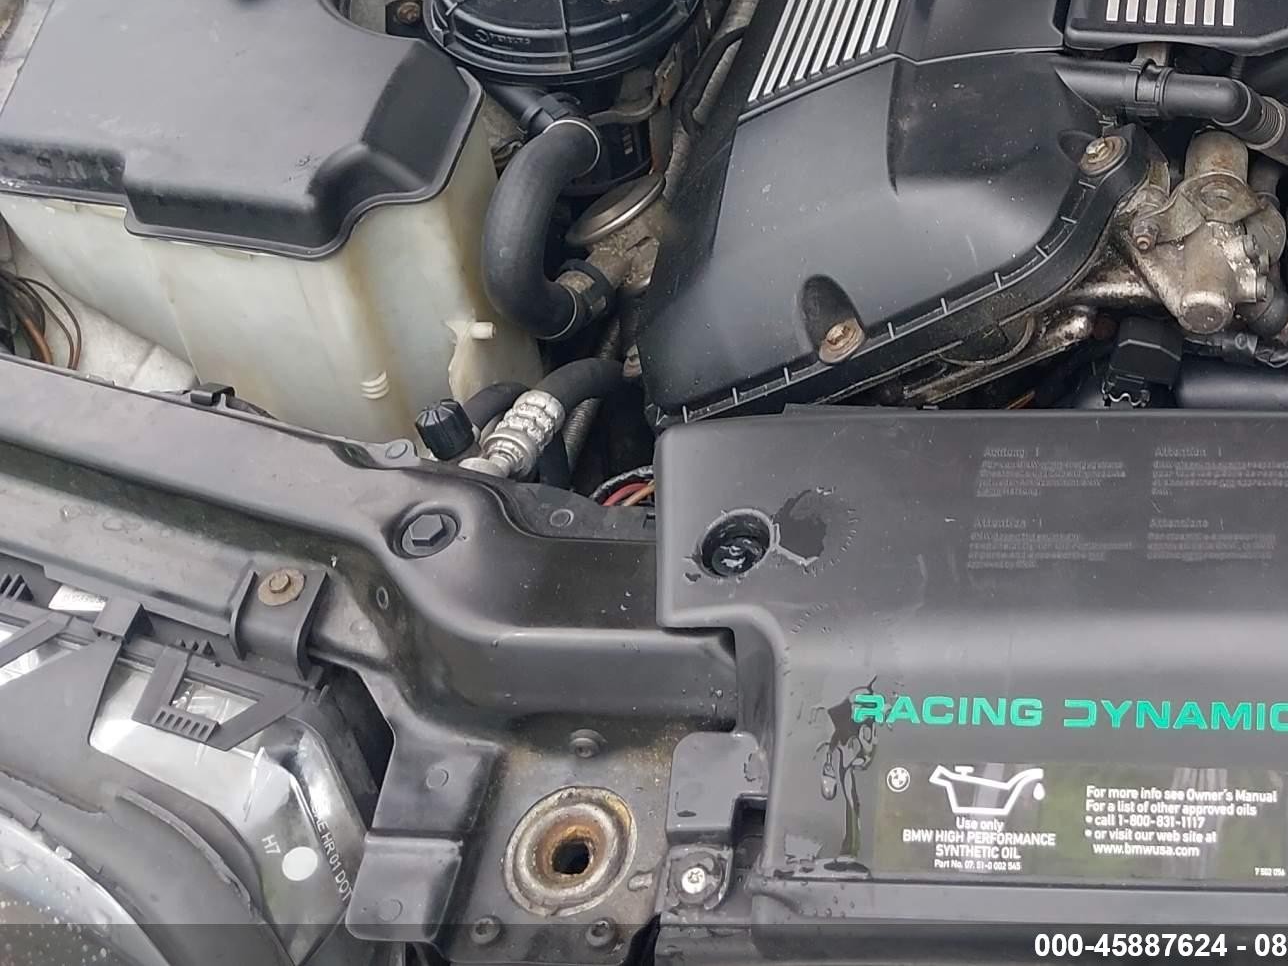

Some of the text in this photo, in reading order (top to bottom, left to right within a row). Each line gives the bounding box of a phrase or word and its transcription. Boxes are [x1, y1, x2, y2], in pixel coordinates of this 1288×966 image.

[851, 694, 1043, 728] RACING
[1086, 785, 1278, 803] For more info see Owner's Manual
[1086, 799, 1258, 818] For a list of other approved oils
[955, 817, 1004, 833] Use only
[1094, 814, 1206, 829] call 1-800-831-1117
[262, 834, 281, 854] H7
[902, 829, 1057, 846] BMW HIGH PERFORMANCE
[1094, 828, 1217, 844] or visit our web site at
[935, 844, 1022, 860] SYNTHETIC OIL
[1093, 842, 1200, 857] www.bmwusa.com
[321, 832, 336, 856] HR
[335, 870, 353, 901] DOT
[934, 859, 950, 869] Part
